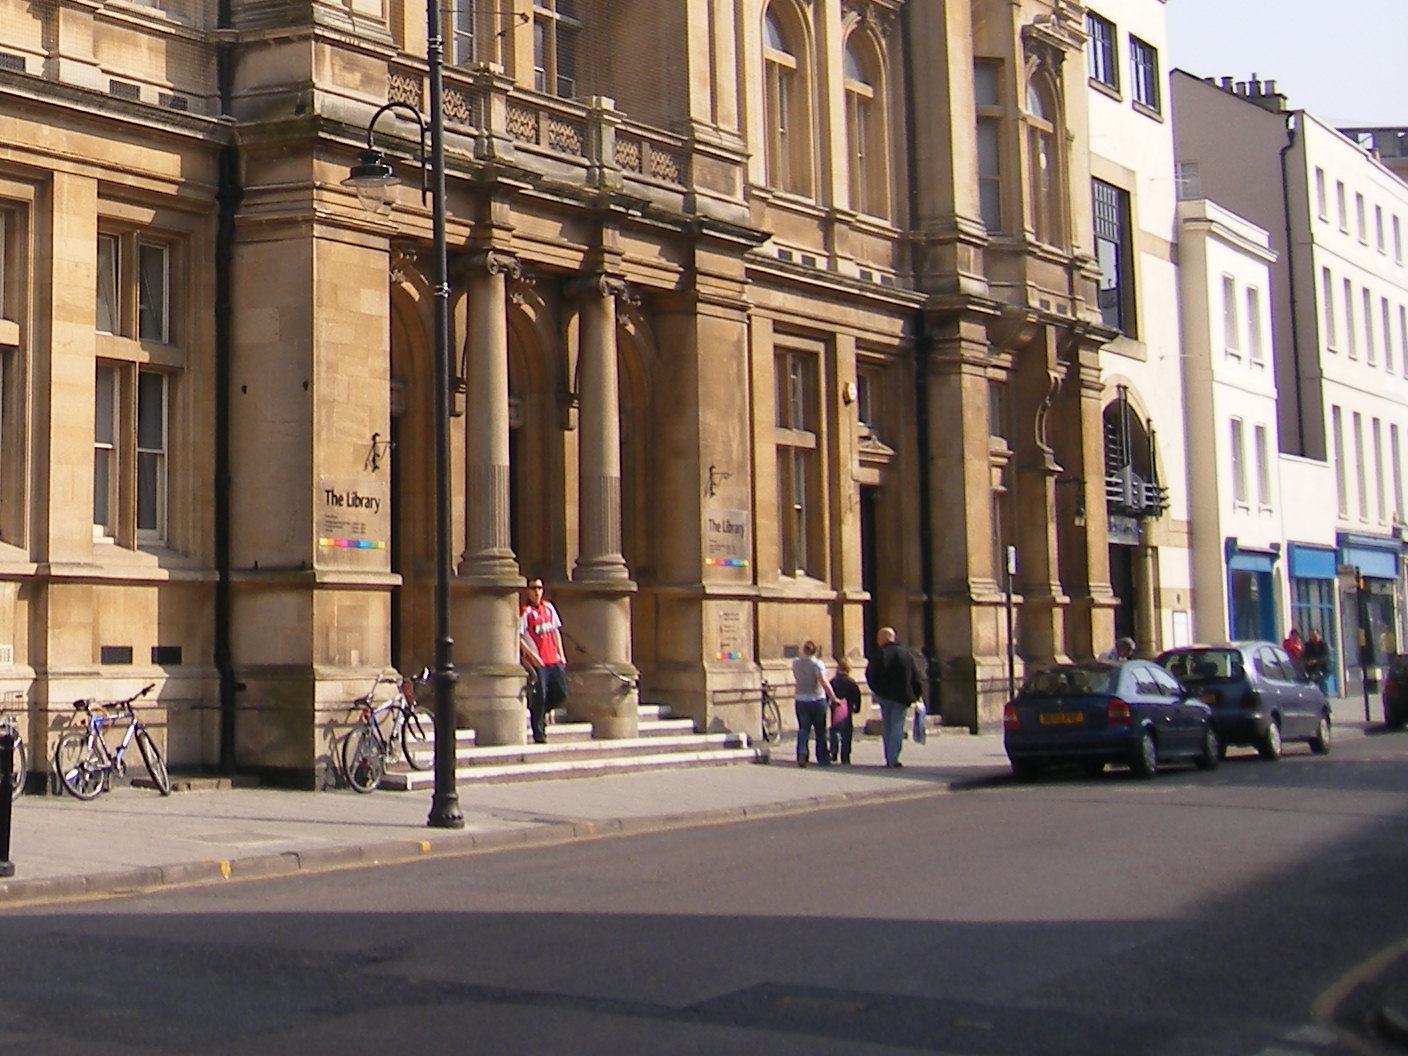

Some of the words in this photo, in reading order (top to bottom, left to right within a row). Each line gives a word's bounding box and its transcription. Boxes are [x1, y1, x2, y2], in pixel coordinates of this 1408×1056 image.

[325, 488, 344, 507] The
[346, 490, 381, 515] Library
[708, 518, 721, 533] The
[722, 519, 745, 539] Library
